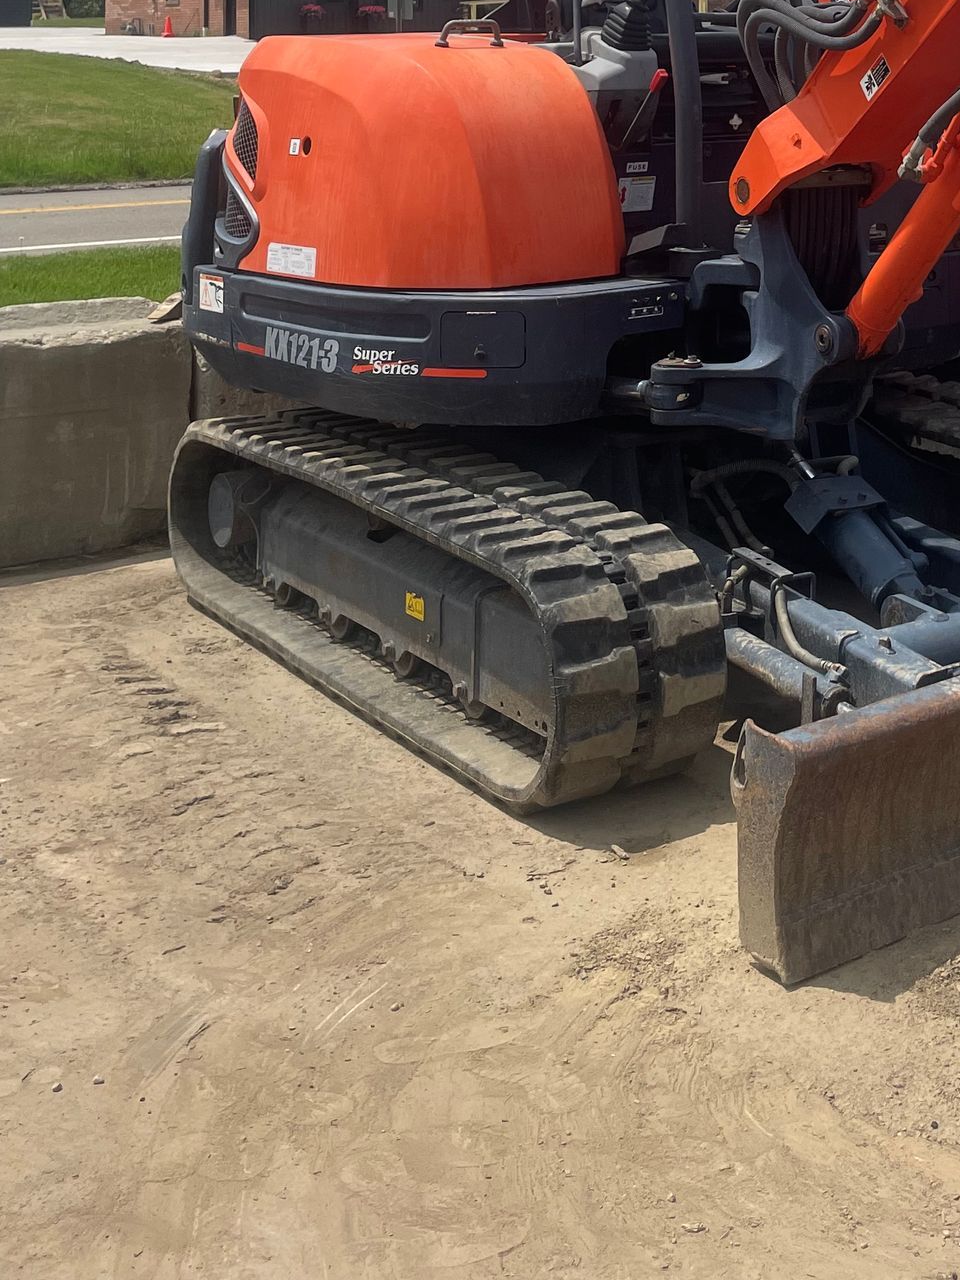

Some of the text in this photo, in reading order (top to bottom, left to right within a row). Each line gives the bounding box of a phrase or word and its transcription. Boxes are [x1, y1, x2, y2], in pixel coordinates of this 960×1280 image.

[264, 326, 340, 374] KX121-3
[353, 346, 395, 365] Super
[372, 360, 419, 376] Series
